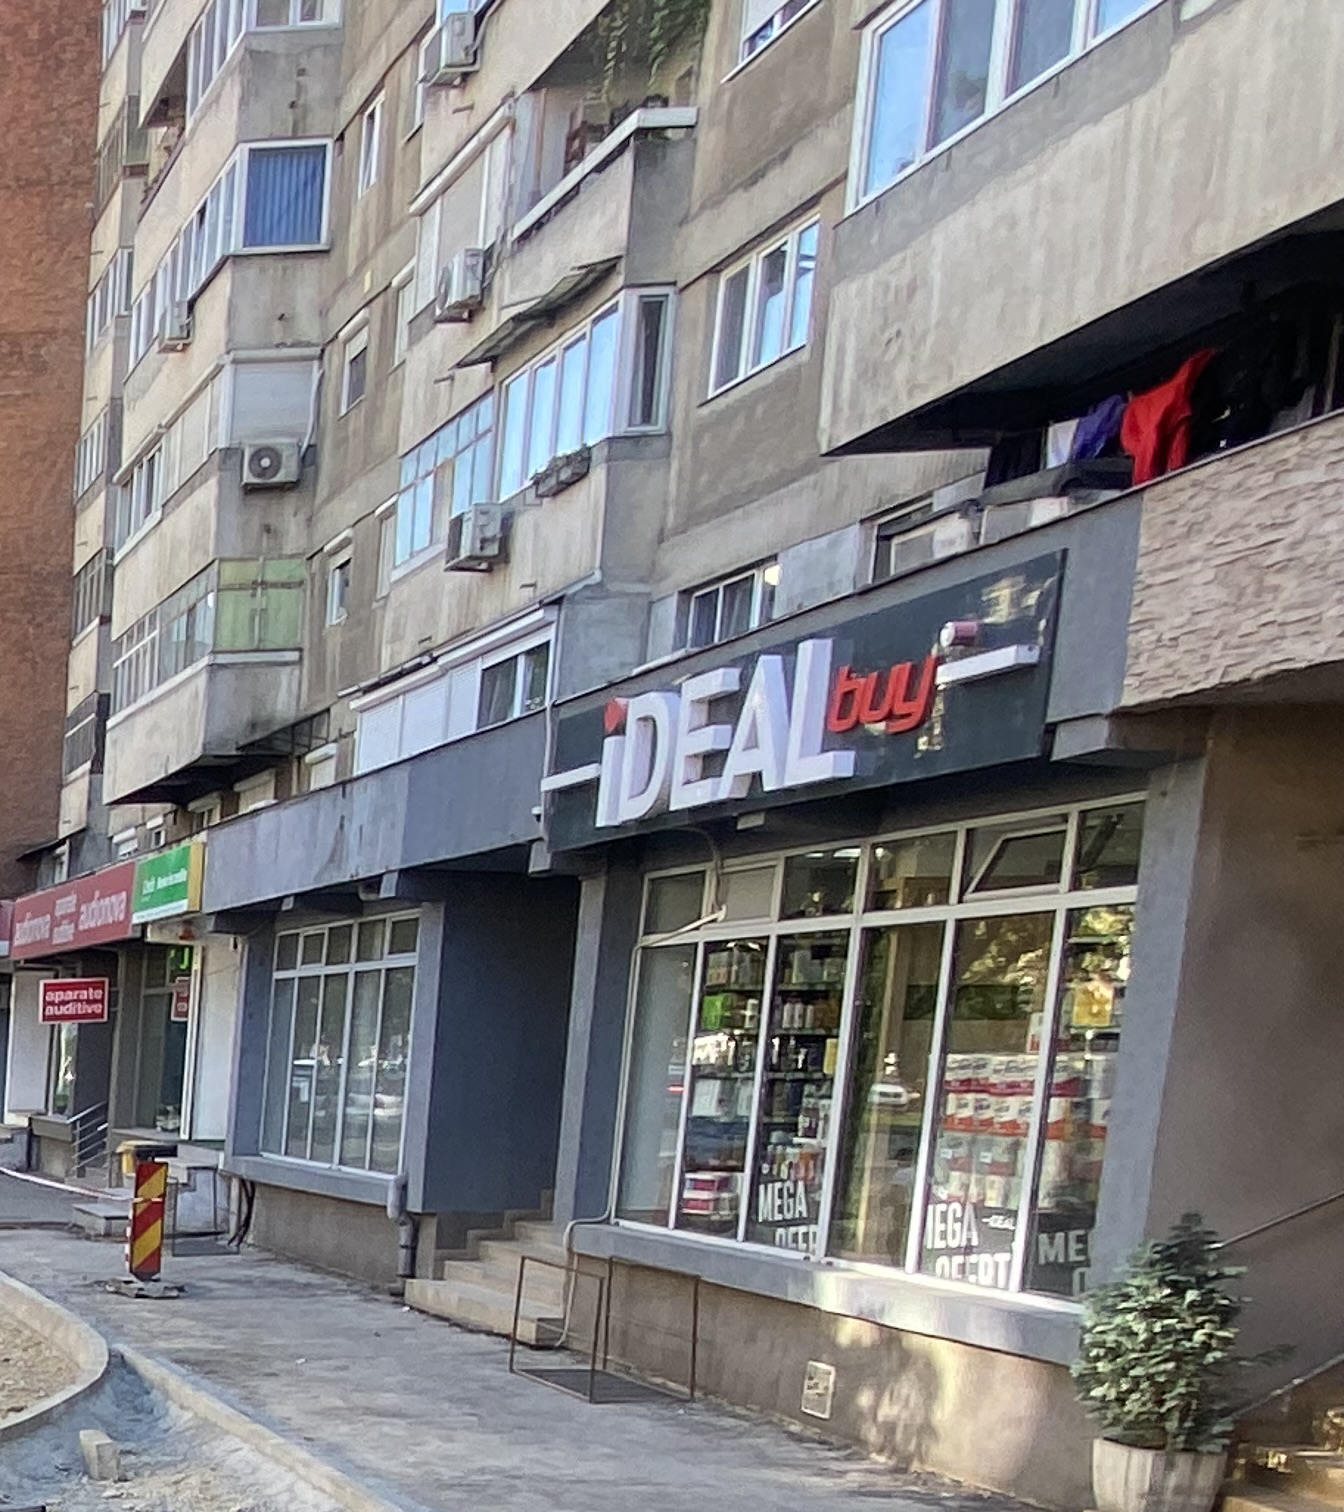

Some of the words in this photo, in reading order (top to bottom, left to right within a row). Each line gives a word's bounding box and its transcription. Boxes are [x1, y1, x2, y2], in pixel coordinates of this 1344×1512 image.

[595, 638, 856, 828] iDEAL
[827, 655, 938, 733] buy
[44, 1001, 103, 1016] auditive
[45, 987, 103, 1003] aparate
[758, 1179, 808, 1222] MEGA
